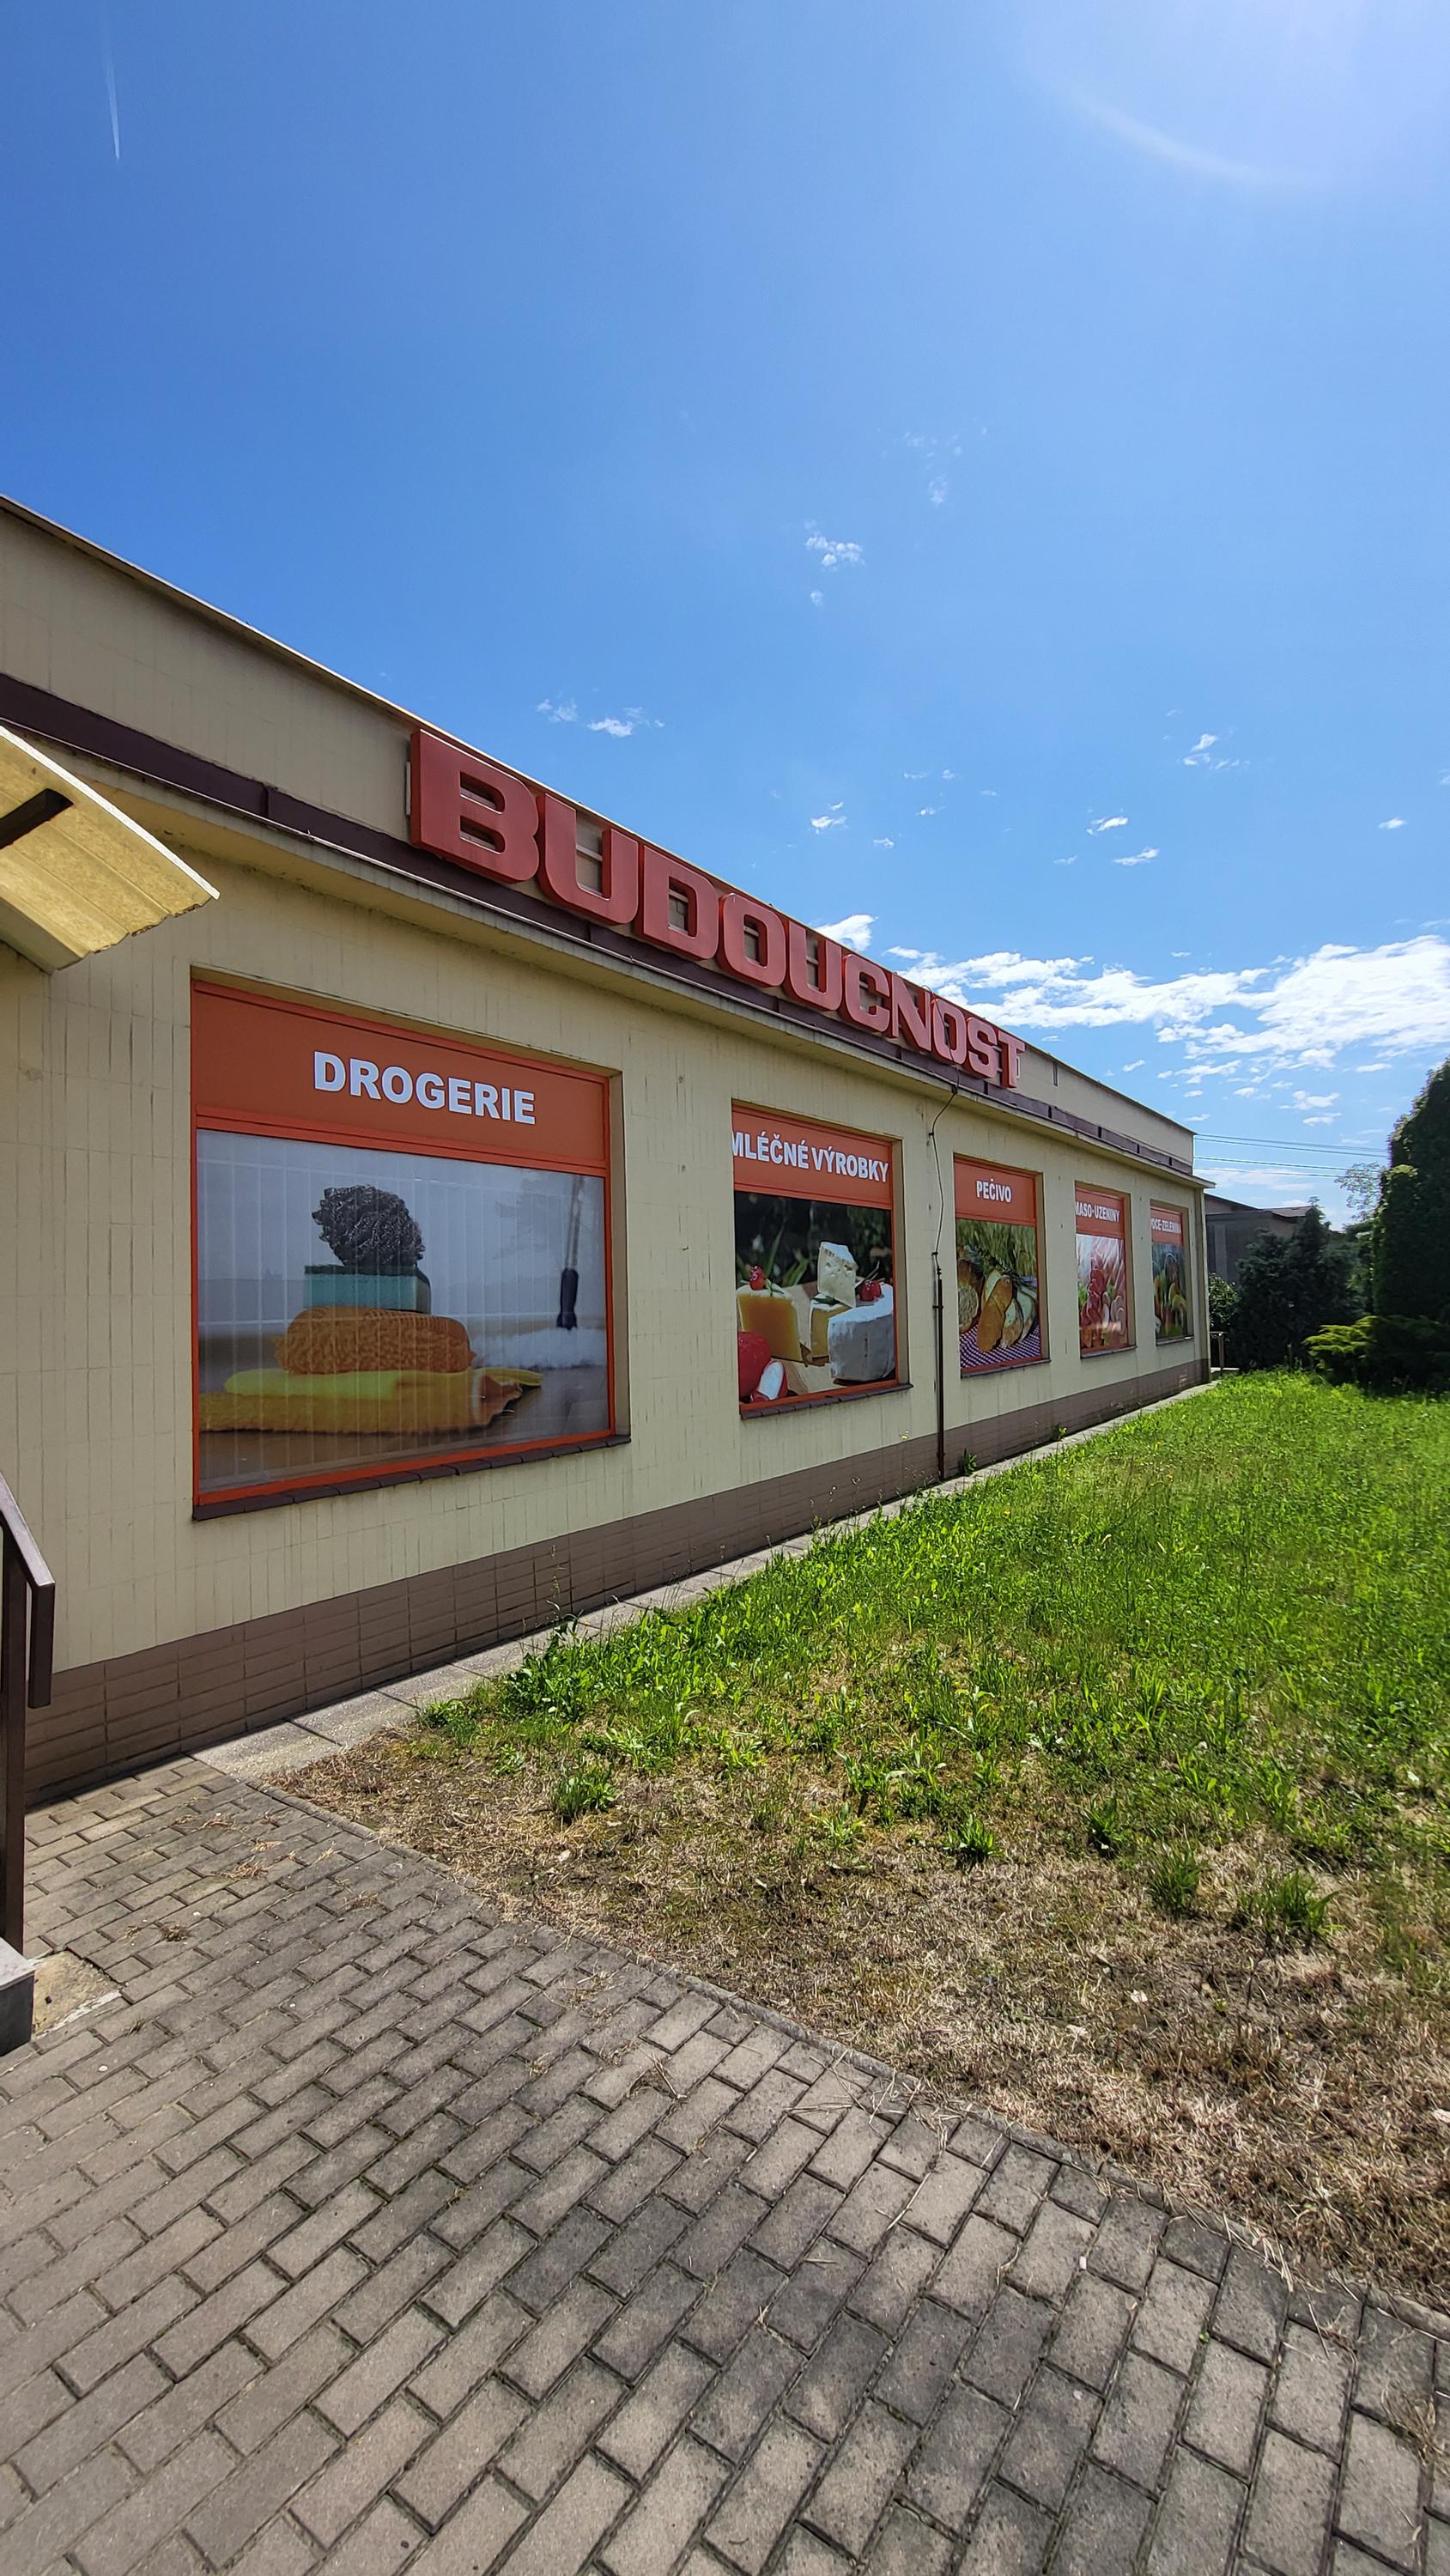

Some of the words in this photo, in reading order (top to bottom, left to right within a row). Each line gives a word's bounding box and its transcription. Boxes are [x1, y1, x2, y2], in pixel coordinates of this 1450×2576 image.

[410, 728, 1026, 1089] BUDOUCNOST
[314, 1051, 536, 1125] DROGERIE
[810, 1145, 889, 1183] VÝROBKY
[976, 1177, 1012, 1203] PEČIVO
